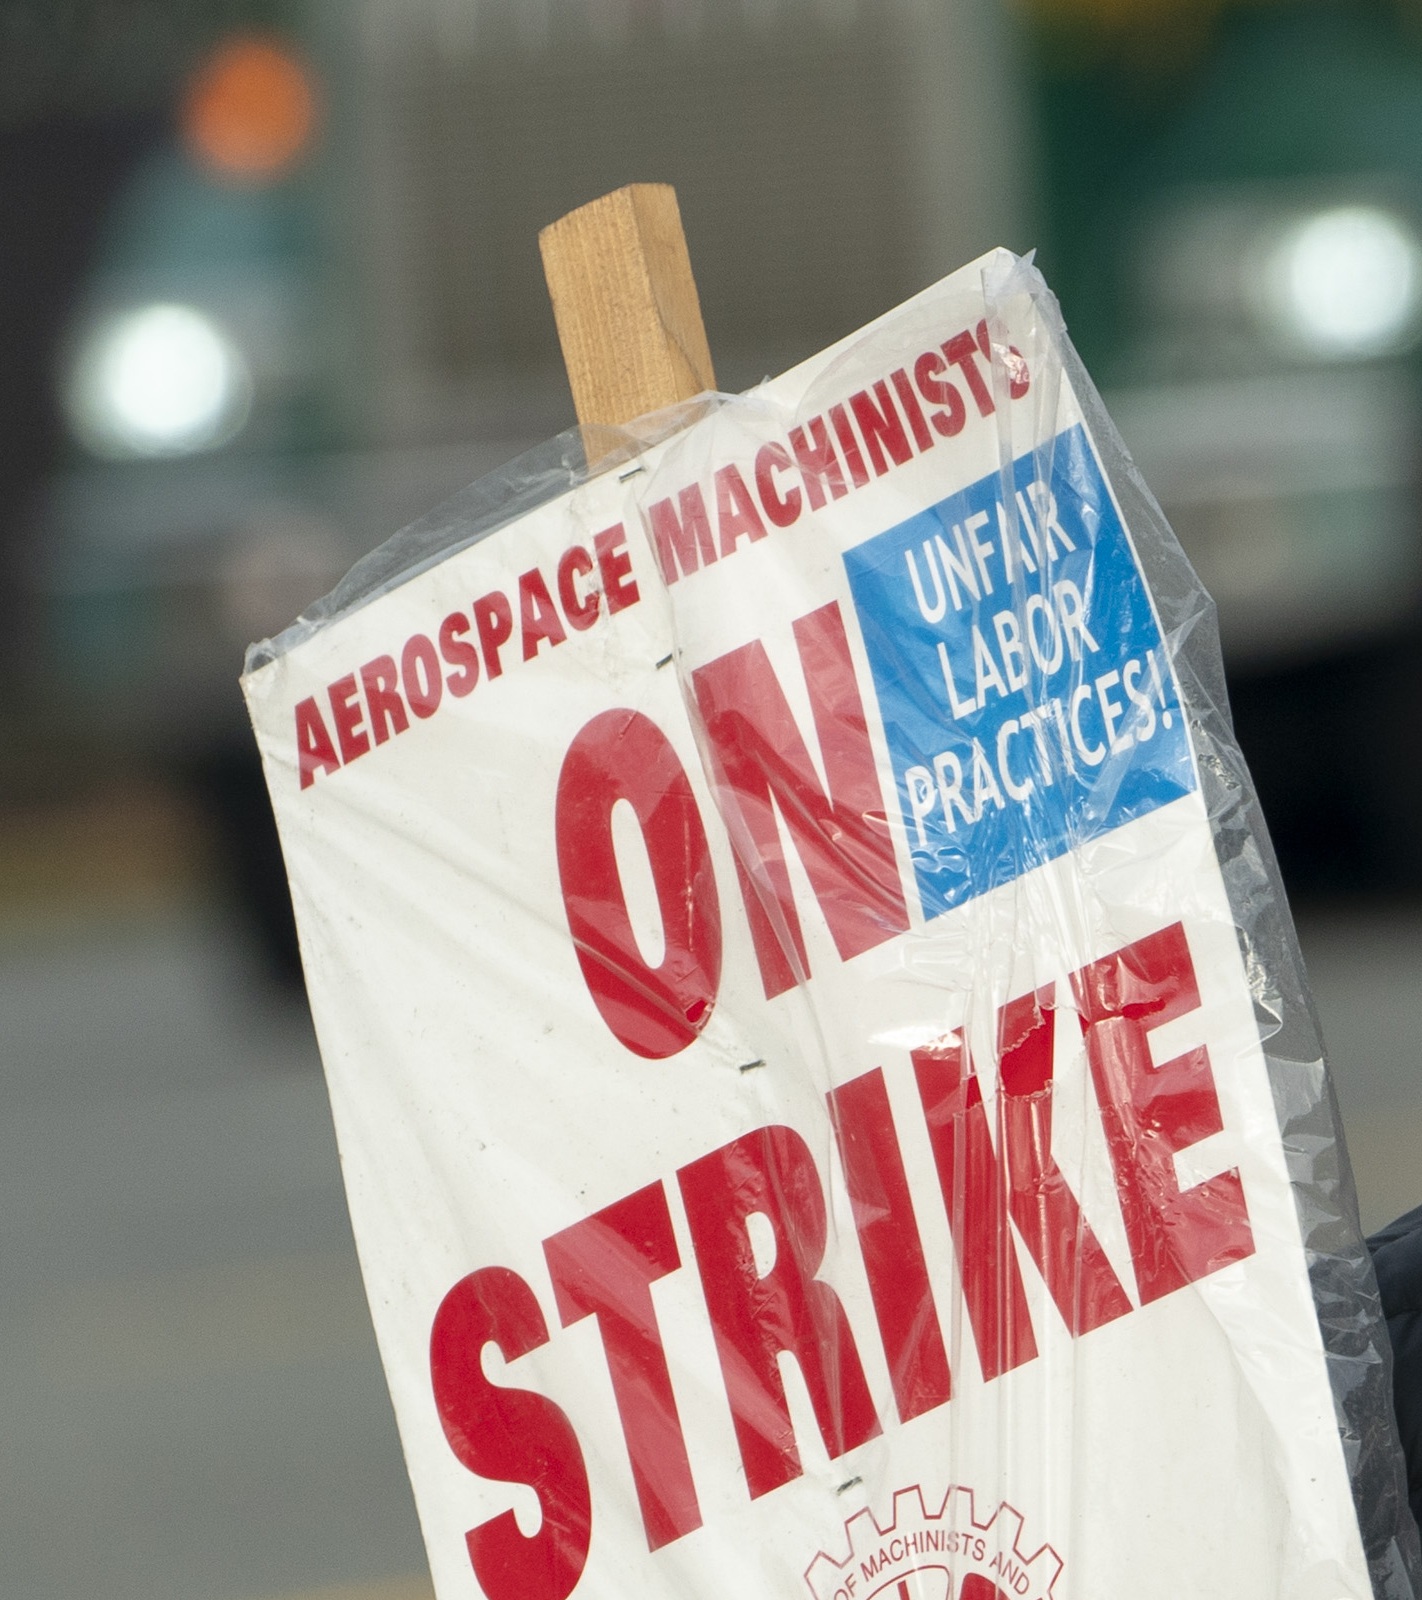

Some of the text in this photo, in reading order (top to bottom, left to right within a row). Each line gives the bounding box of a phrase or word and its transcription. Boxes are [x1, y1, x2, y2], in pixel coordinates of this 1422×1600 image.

[294, 318, 1031, 790] AEROSPACE MACHINISTS
[904, 479, 1076, 623] UNFAIR
[937, 579, 1099, 720] LABOR
[555, 599, 911, 1060] ON
[904, 649, 1173, 846] PRACTICES!
[860, 1528, 986, 1584] MACHINISTS
[989, 1551, 1030, 1595] AND
